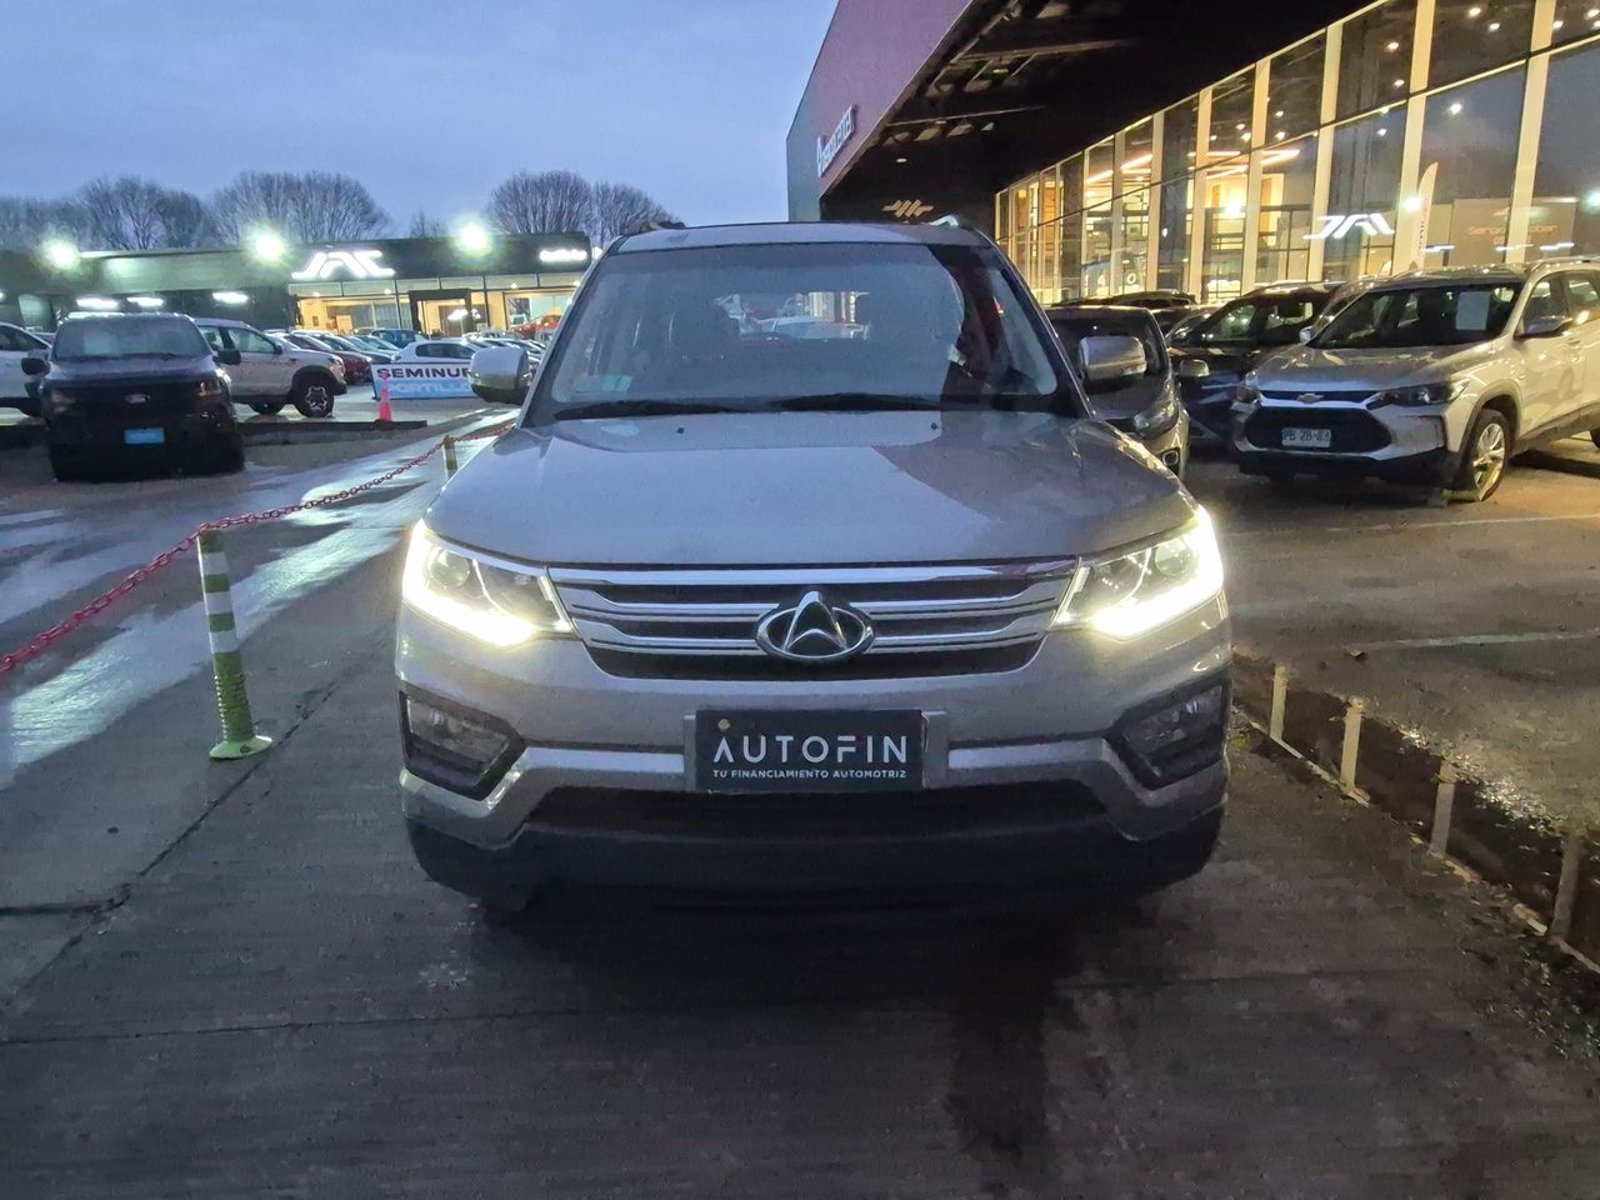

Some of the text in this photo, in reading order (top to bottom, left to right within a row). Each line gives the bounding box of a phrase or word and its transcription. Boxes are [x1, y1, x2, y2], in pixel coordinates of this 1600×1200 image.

[713, 735, 907, 763] AUTOFIN
[712, 769, 907, 779] TU FINANCIAMIENTO AUTOMOTRIZ
